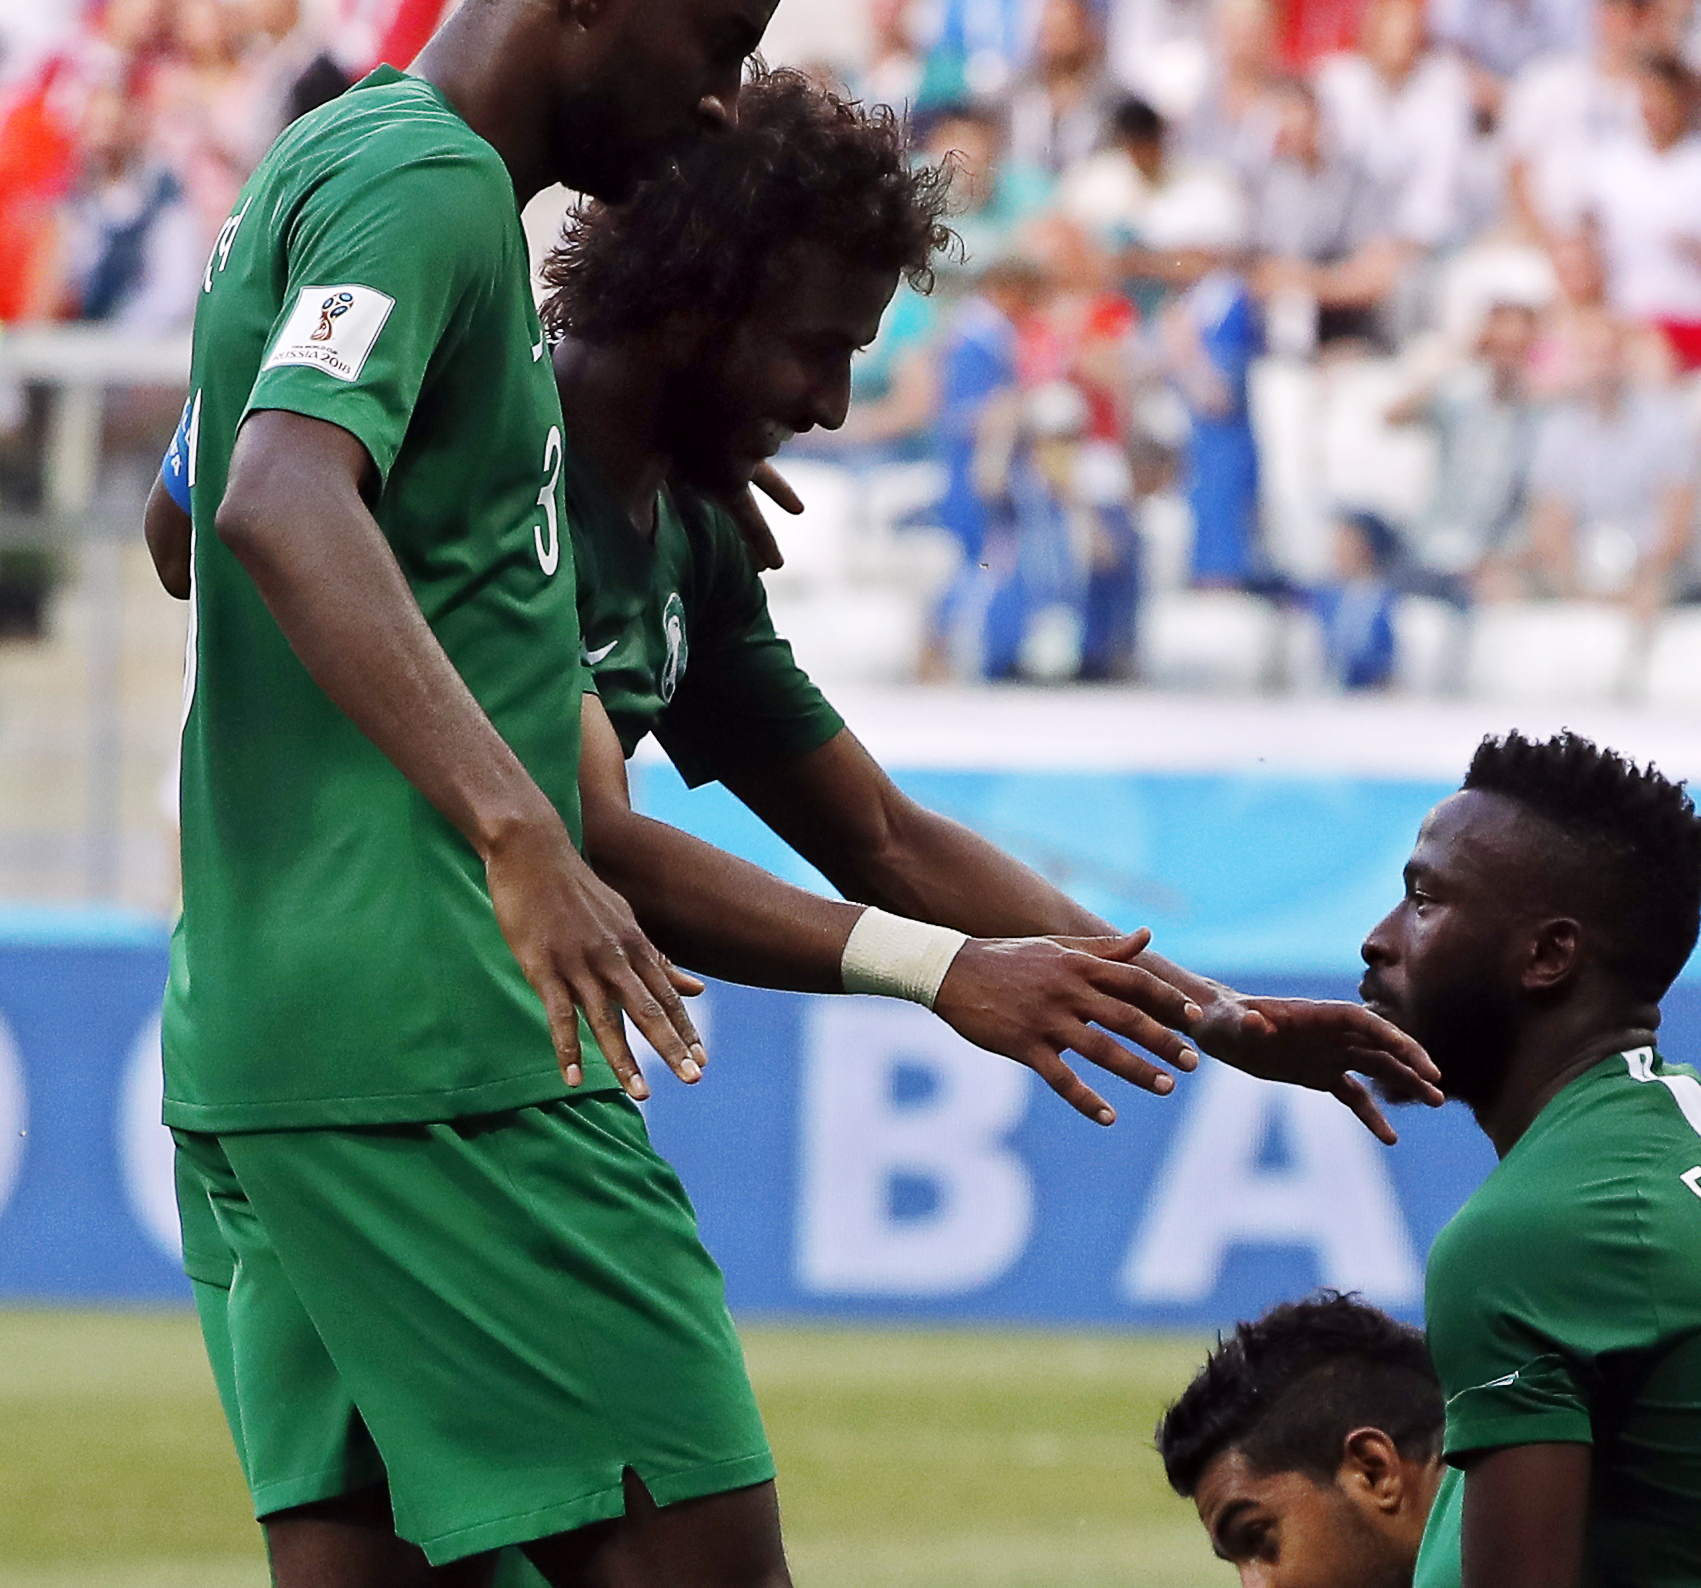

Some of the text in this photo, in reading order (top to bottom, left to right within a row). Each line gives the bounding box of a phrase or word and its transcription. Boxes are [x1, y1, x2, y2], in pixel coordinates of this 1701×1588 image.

[273, 350, 352, 375] RUSSIA 2018
[533, 424, 563, 577] 3
